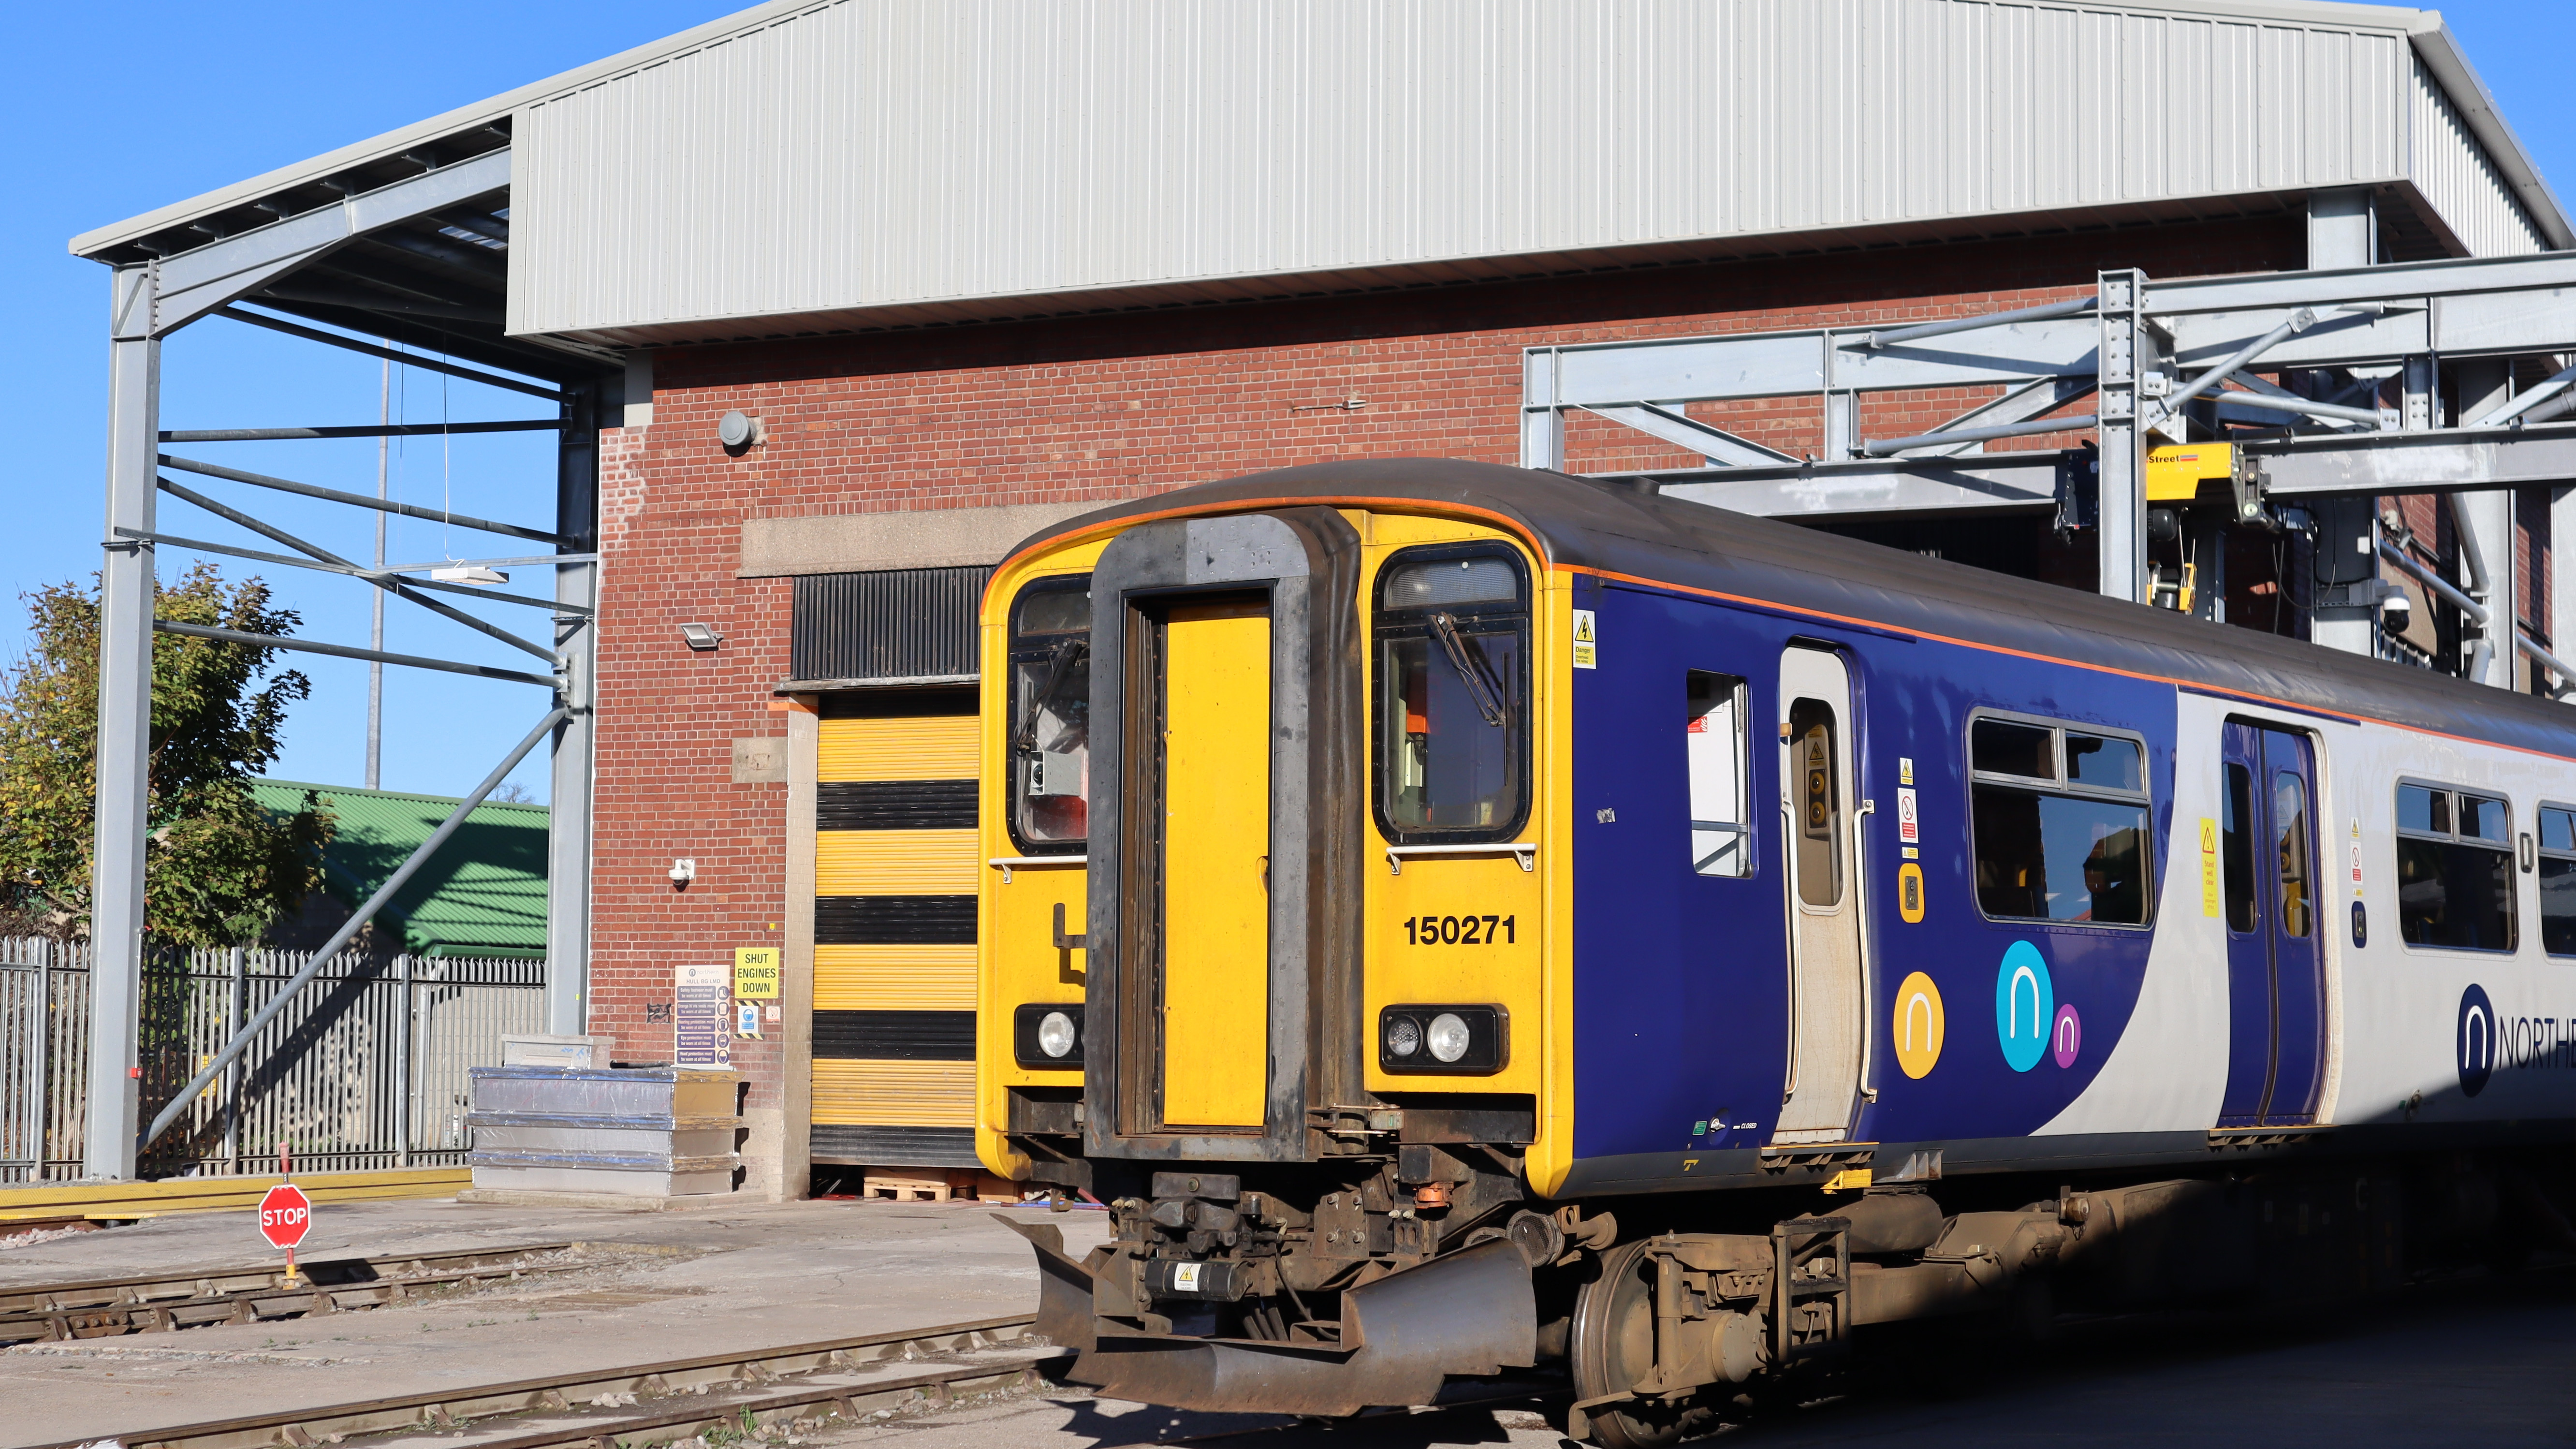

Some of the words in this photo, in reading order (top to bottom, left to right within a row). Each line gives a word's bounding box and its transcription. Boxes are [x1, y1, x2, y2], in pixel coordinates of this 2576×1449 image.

[1404, 915, 1514, 945] 150271
[745, 953, 769, 964] SHUT
[737, 968, 776, 978] ENGINES
[743, 982, 770, 993] DOWN
[263, 1208, 307, 1227] STOP
